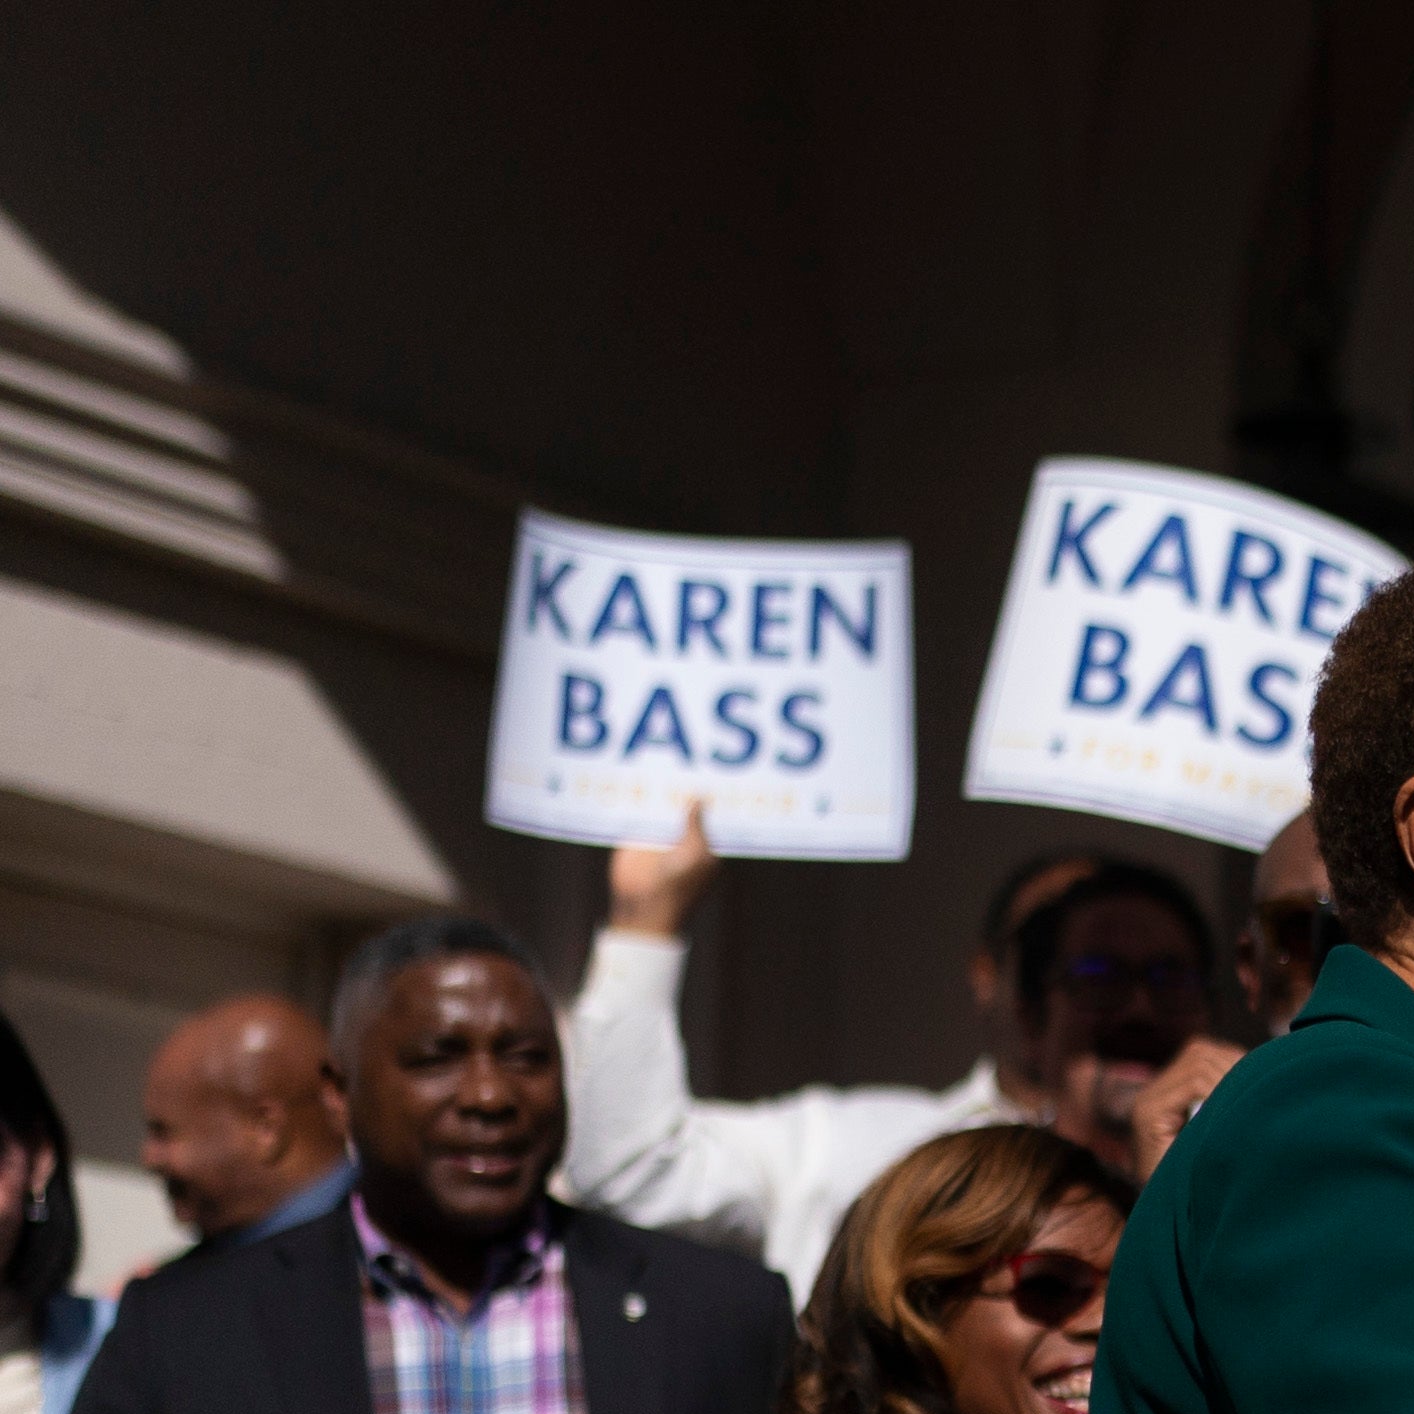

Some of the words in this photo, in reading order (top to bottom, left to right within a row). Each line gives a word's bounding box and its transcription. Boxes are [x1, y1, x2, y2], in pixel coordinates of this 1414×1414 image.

[522, 547, 882, 662] KAREN
[1045, 498, 1374, 642] KARE
[555, 669, 829, 773] BASS
[1067, 619, 1304, 753] BAS
